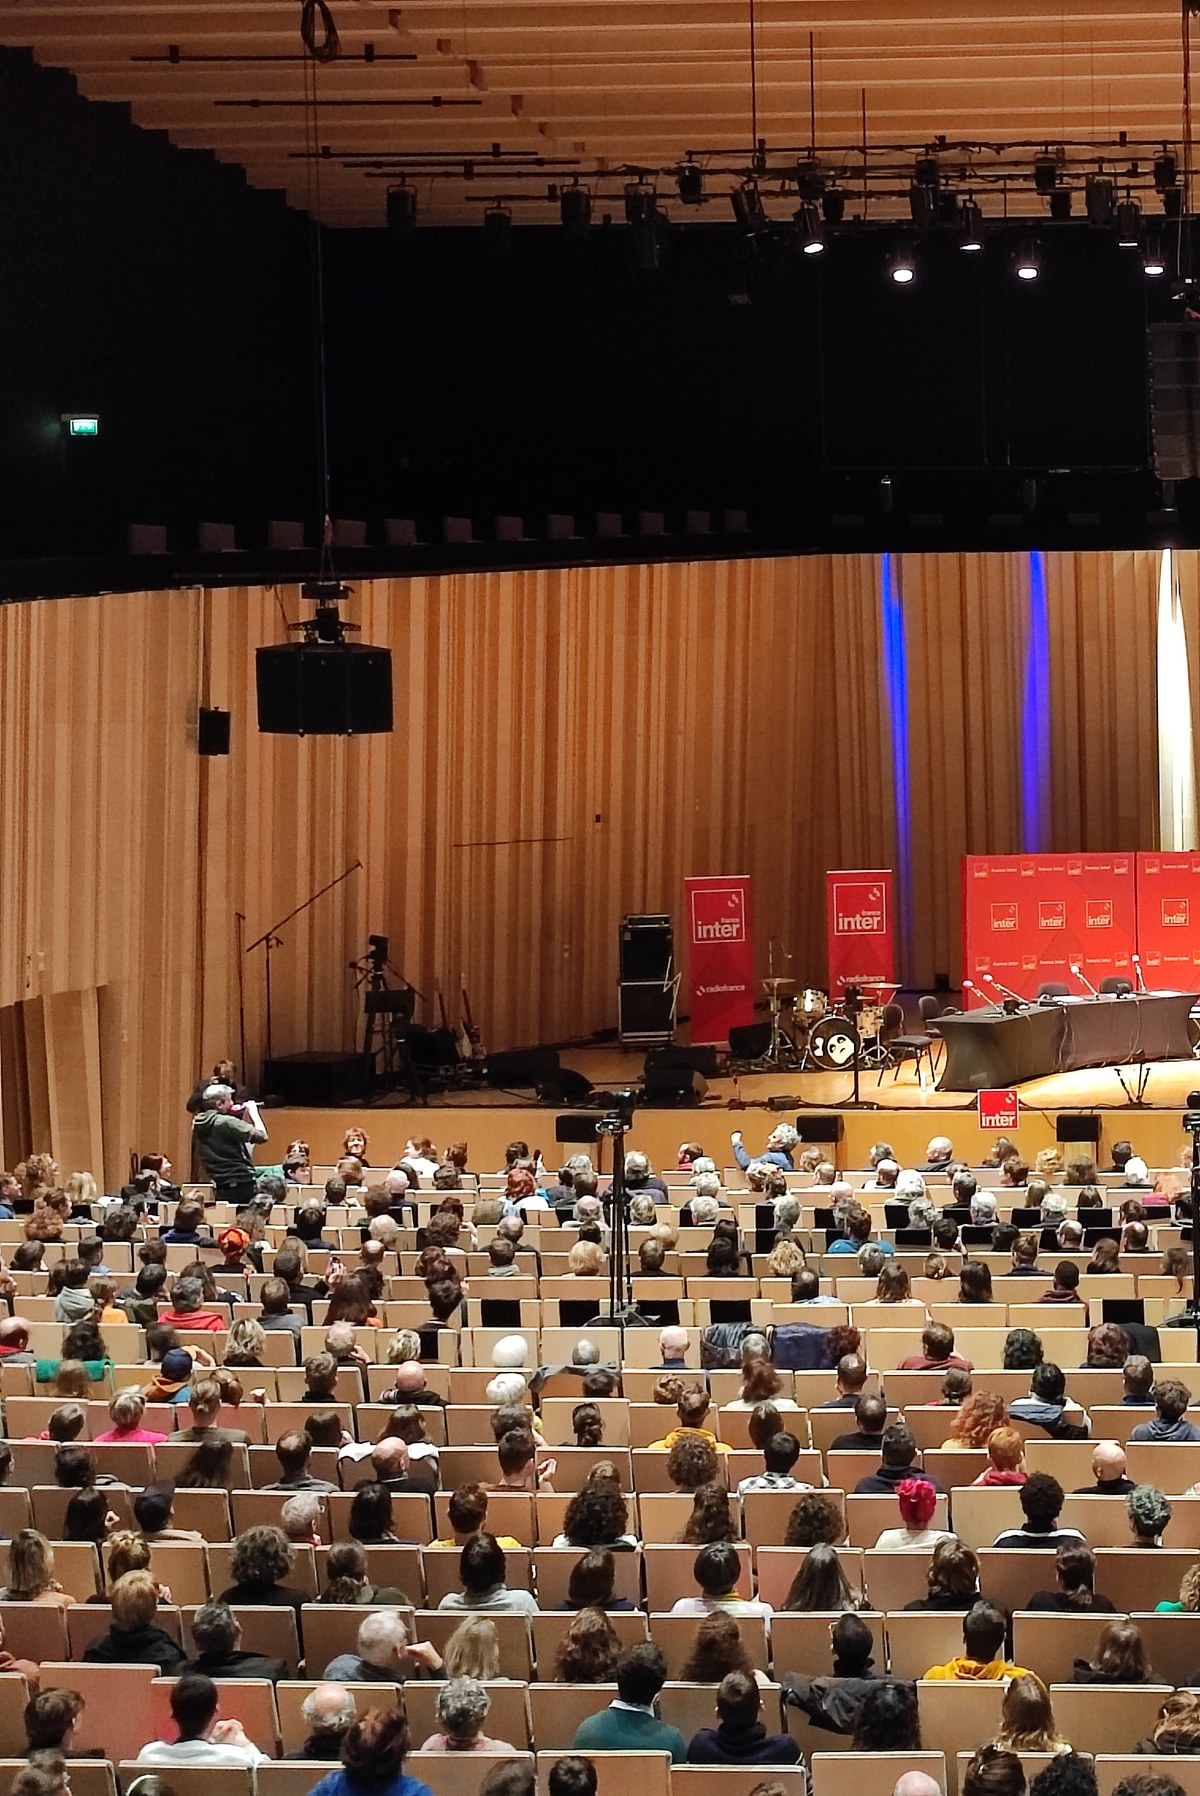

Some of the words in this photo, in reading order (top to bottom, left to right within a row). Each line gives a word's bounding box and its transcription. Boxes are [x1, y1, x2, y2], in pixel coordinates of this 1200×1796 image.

[839, 913, 880, 930] inter
[993, 918, 1016, 928] inter
[1041, 917, 1063, 927] inter
[1088, 916, 1110, 925] inter
[1164, 914, 1186, 923] inter
[697, 921, 740, 939] inter
[706, 985, 745, 993] radiofrance
[982, 1113, 1015, 1126] inter
